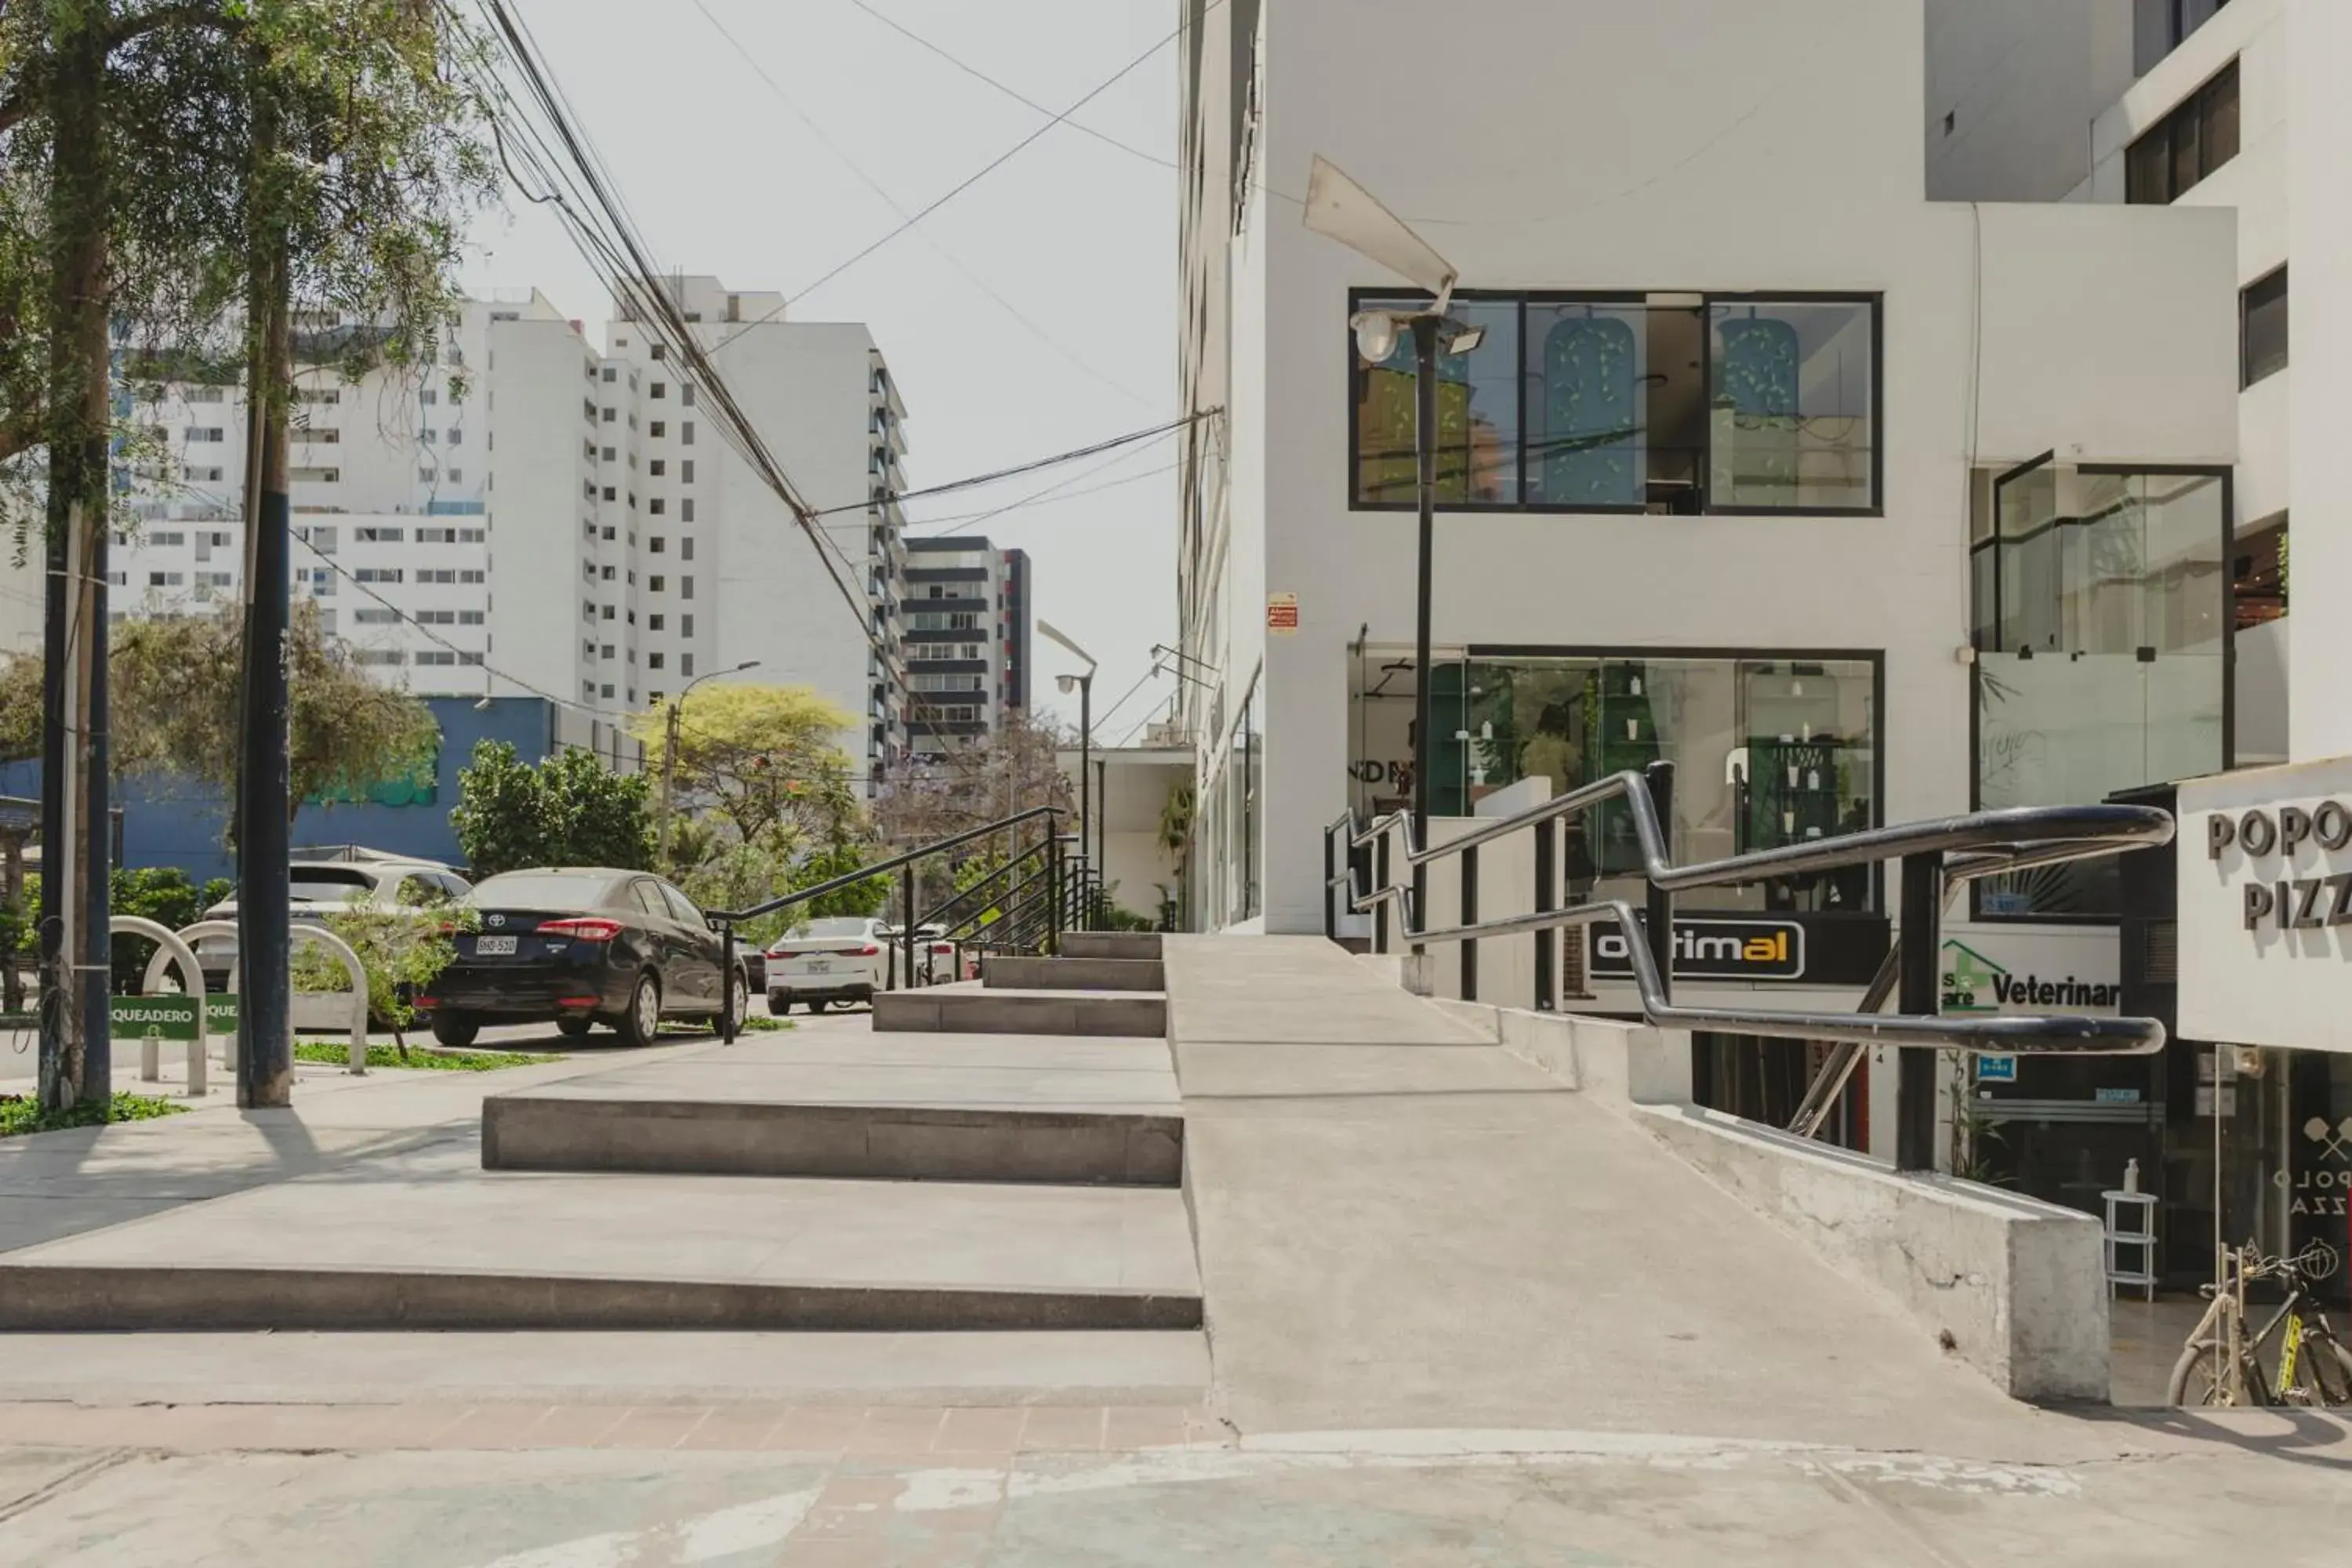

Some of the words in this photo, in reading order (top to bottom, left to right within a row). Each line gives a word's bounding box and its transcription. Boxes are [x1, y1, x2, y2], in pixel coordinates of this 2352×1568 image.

[2208, 800, 2352, 860] POPO
[2244, 873, 2352, 931] PIZZ
[1597, 929, 1788, 962] oimal
[205, 1004, 238, 1018] QUE
